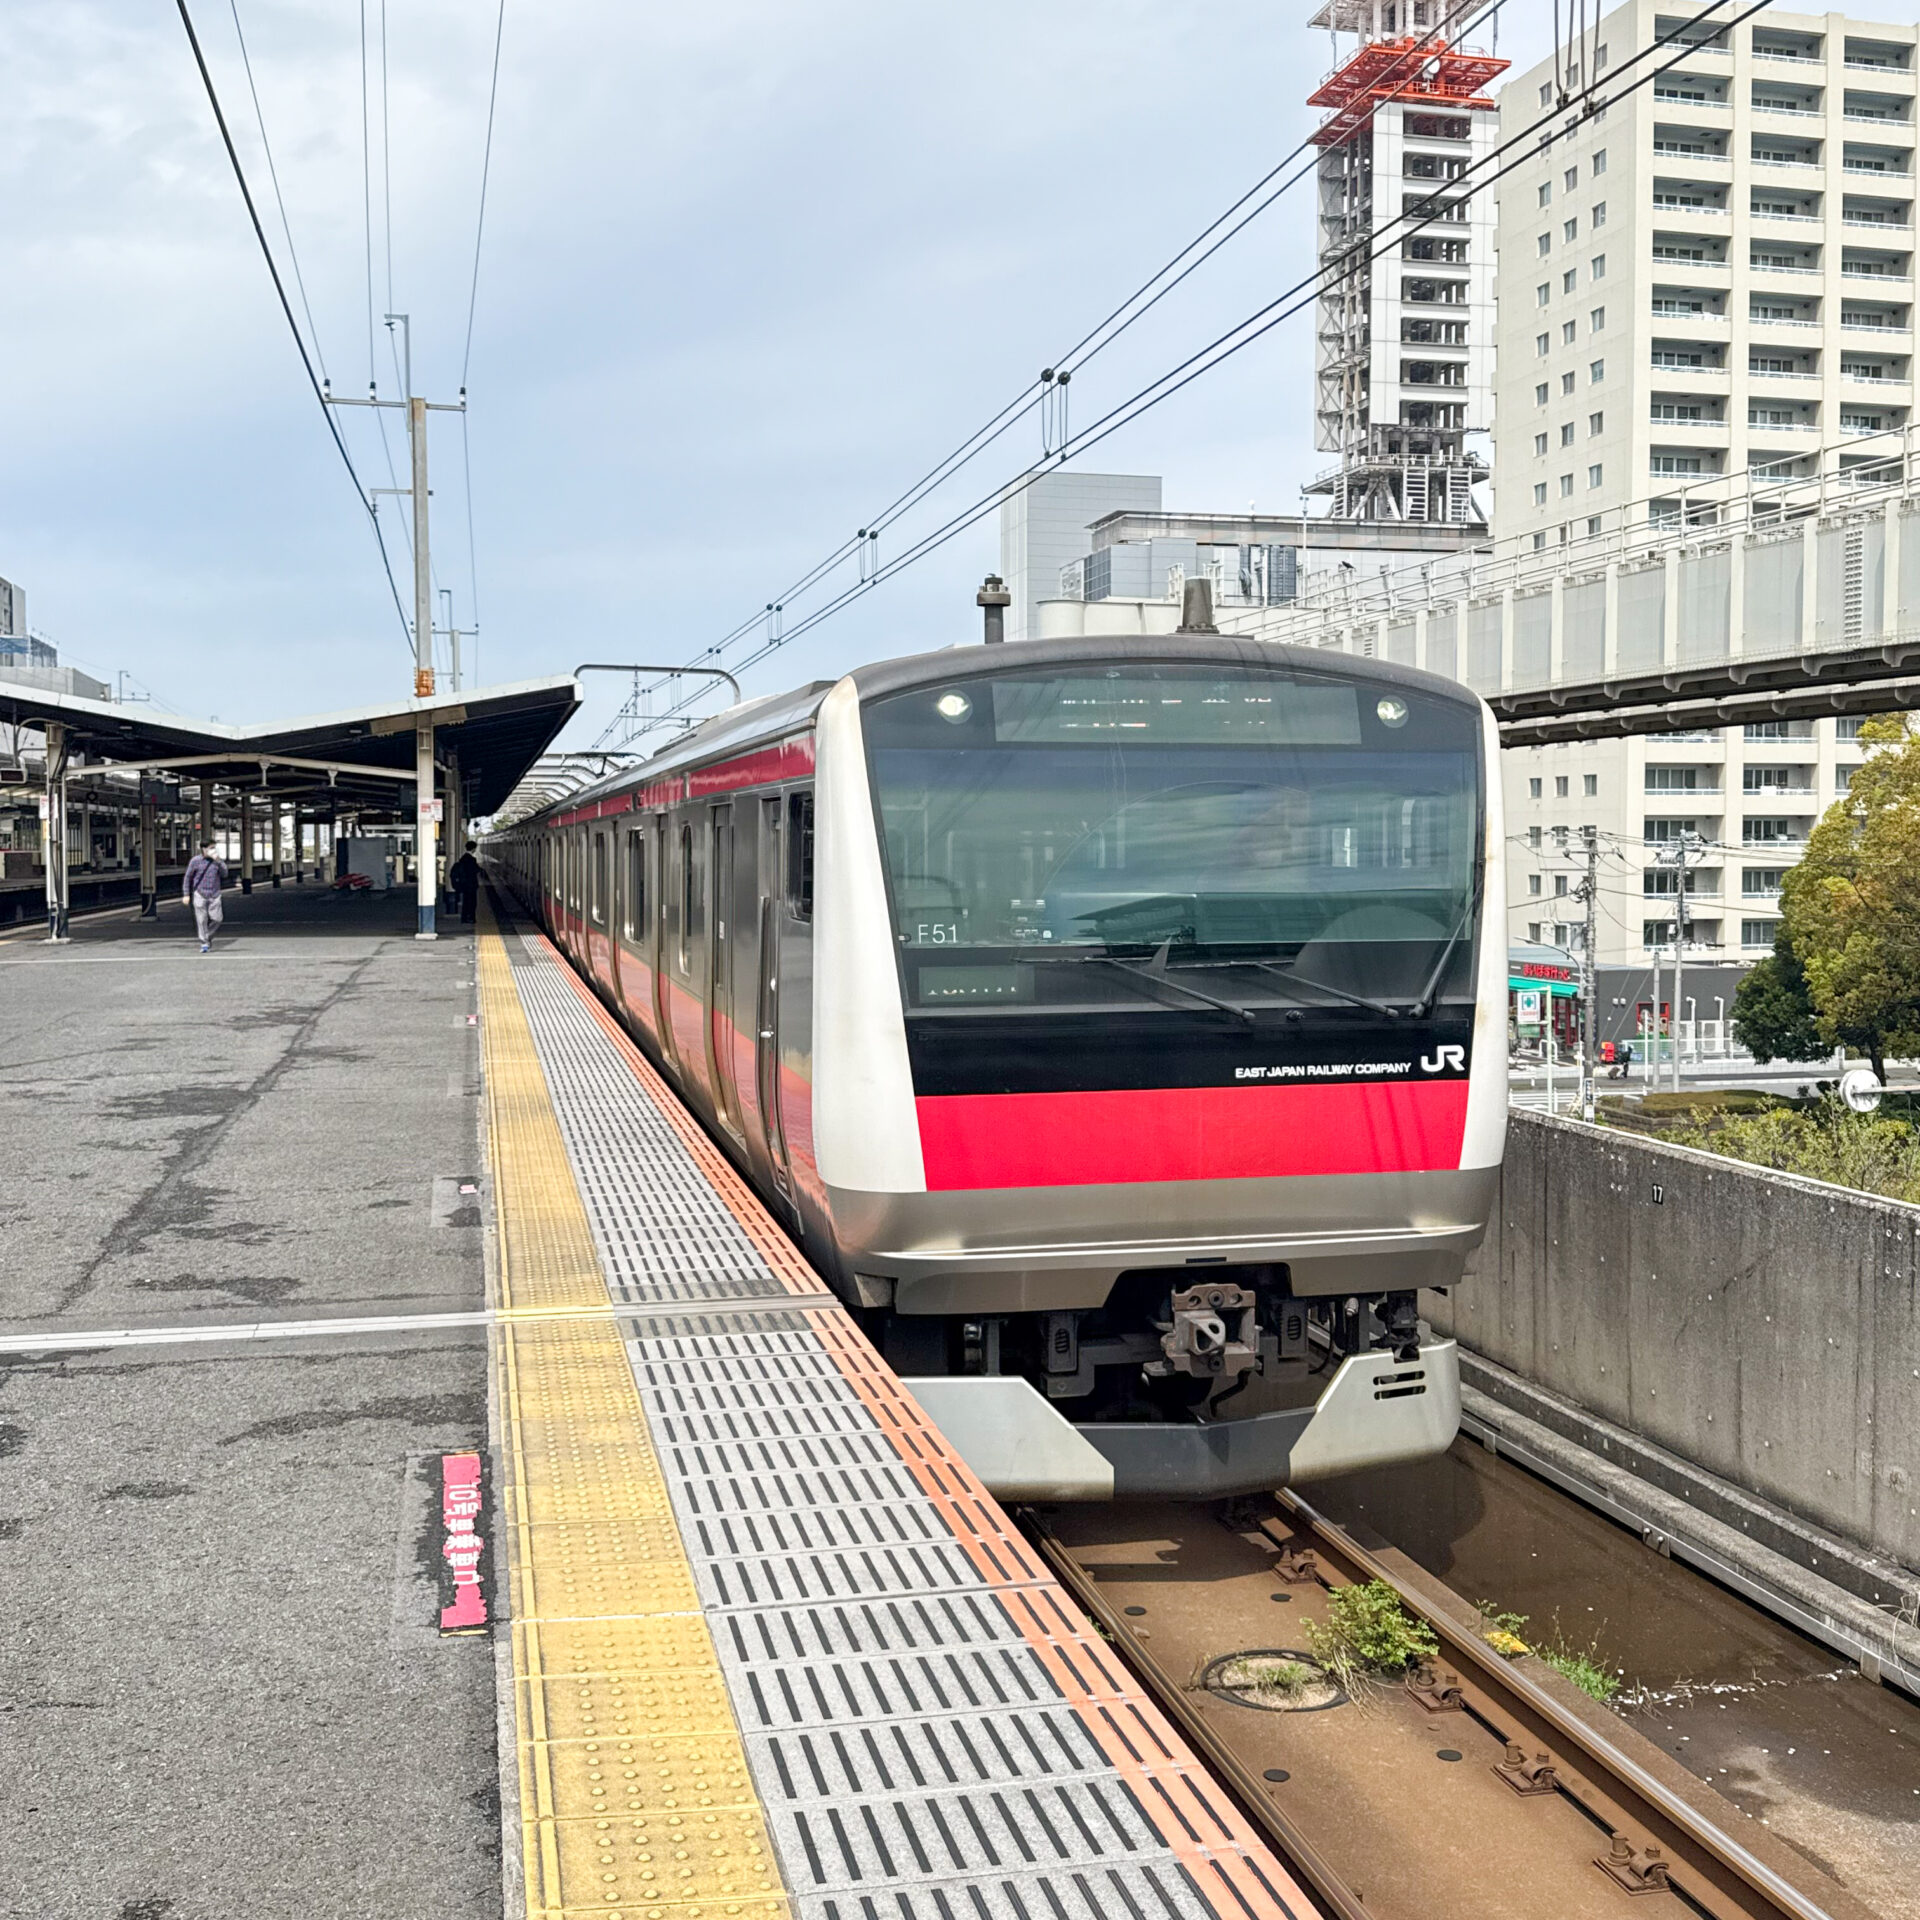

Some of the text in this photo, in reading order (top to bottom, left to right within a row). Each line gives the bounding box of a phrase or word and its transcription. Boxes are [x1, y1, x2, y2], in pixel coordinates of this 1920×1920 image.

[918, 923, 957, 945] F51
[1420, 1044, 1466, 1073] JR
[1235, 1062, 1412, 1079] EAST JAPAN RAILWAY COMPANY
[1652, 1184, 1663, 1203] 17
[446, 1483, 484, 1586] 10号車乗車口
